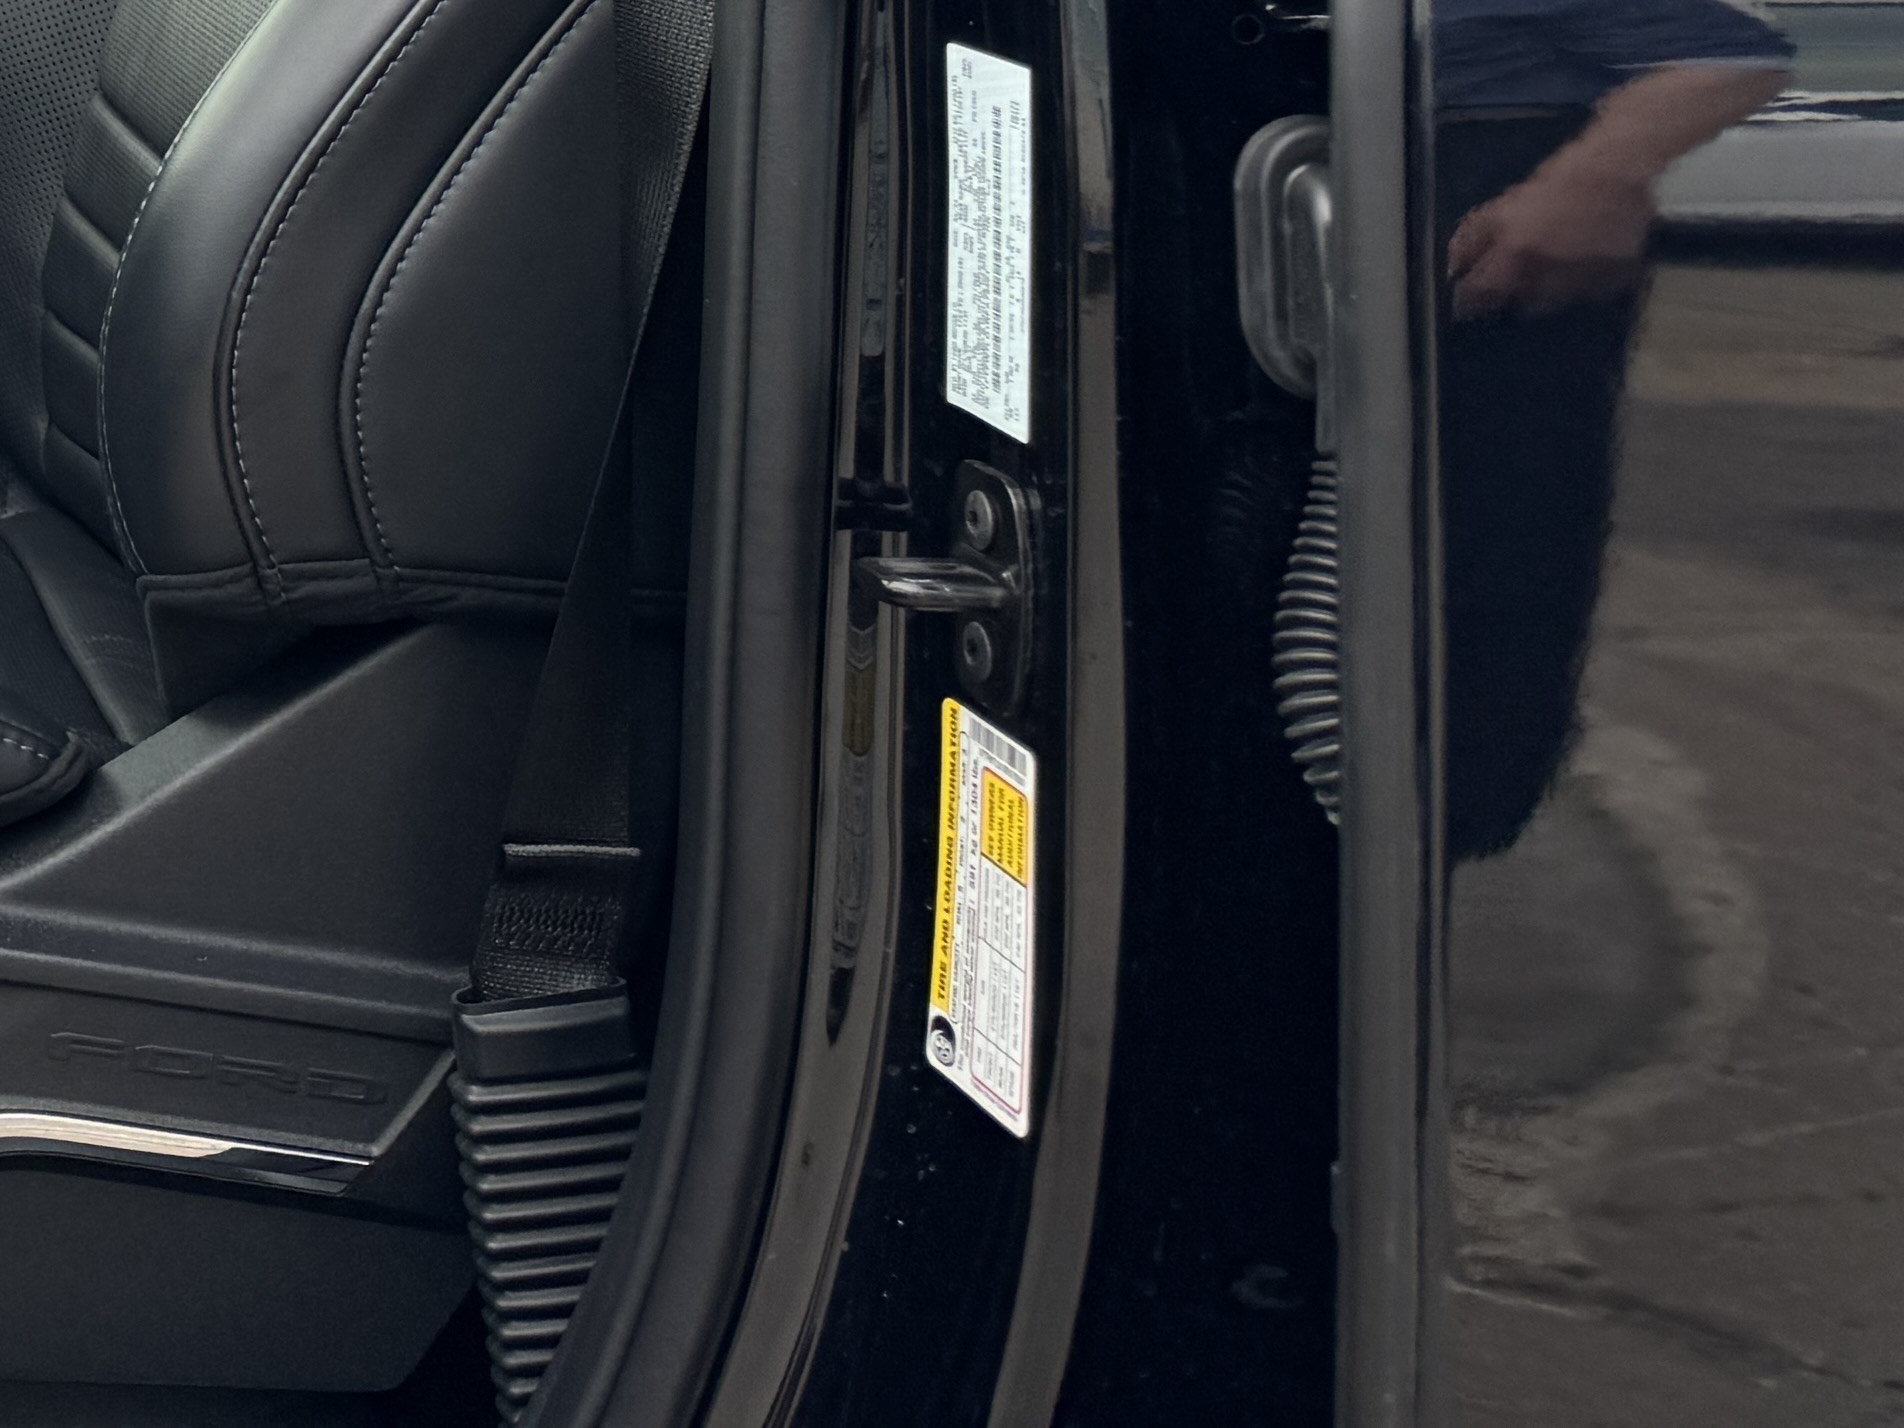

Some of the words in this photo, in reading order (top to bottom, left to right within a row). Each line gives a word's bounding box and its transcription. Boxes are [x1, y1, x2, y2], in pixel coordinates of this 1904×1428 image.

[947, 706, 958, 831] INFORMATION
[943, 835, 955, 915] LOADING
[941, 918, 951, 957] AND
[937, 961, 947, 1001] TIRE
